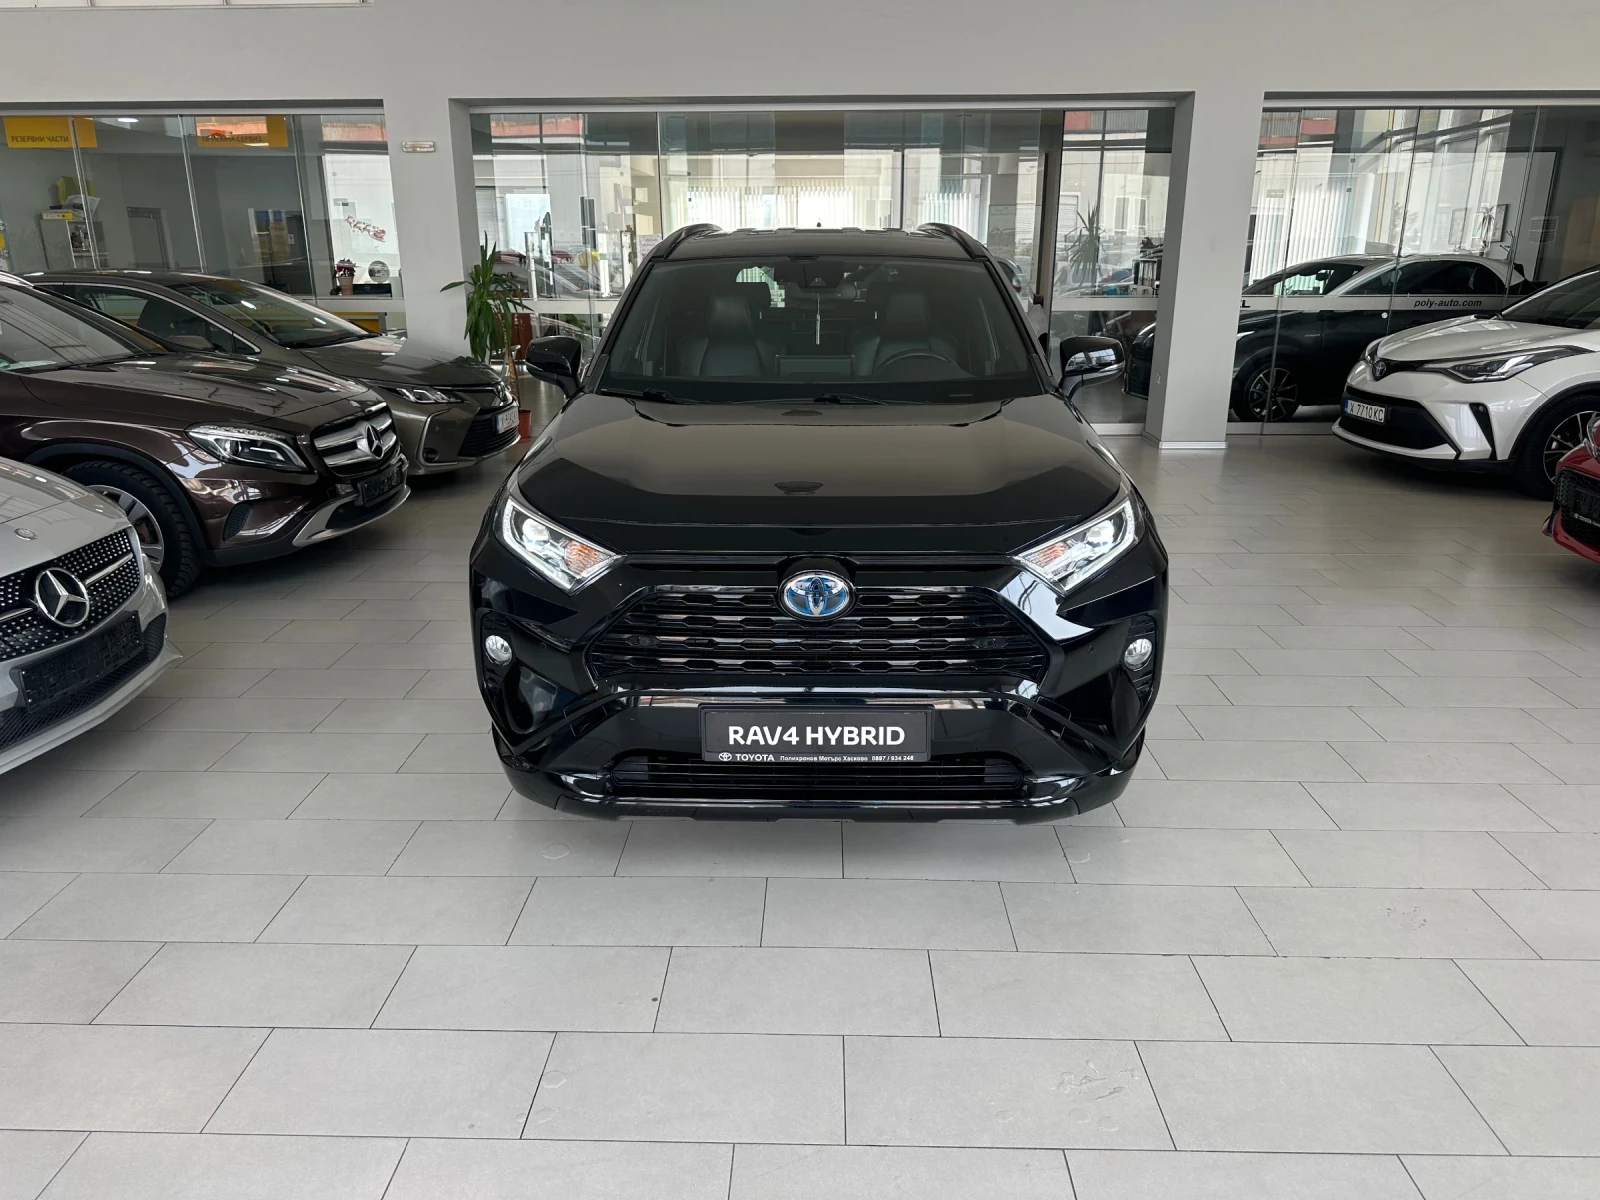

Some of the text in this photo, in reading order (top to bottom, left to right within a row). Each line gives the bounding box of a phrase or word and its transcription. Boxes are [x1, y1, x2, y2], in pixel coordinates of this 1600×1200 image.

[11, 135, 69, 143] РЕЗЕРВНИ ЧАСТИ
[1413, 298, 1482, 308] poly-auto.com
[728, 725, 906, 746] RAV4 HYBRID
[735, 753, 775, 762] TOYOTA
